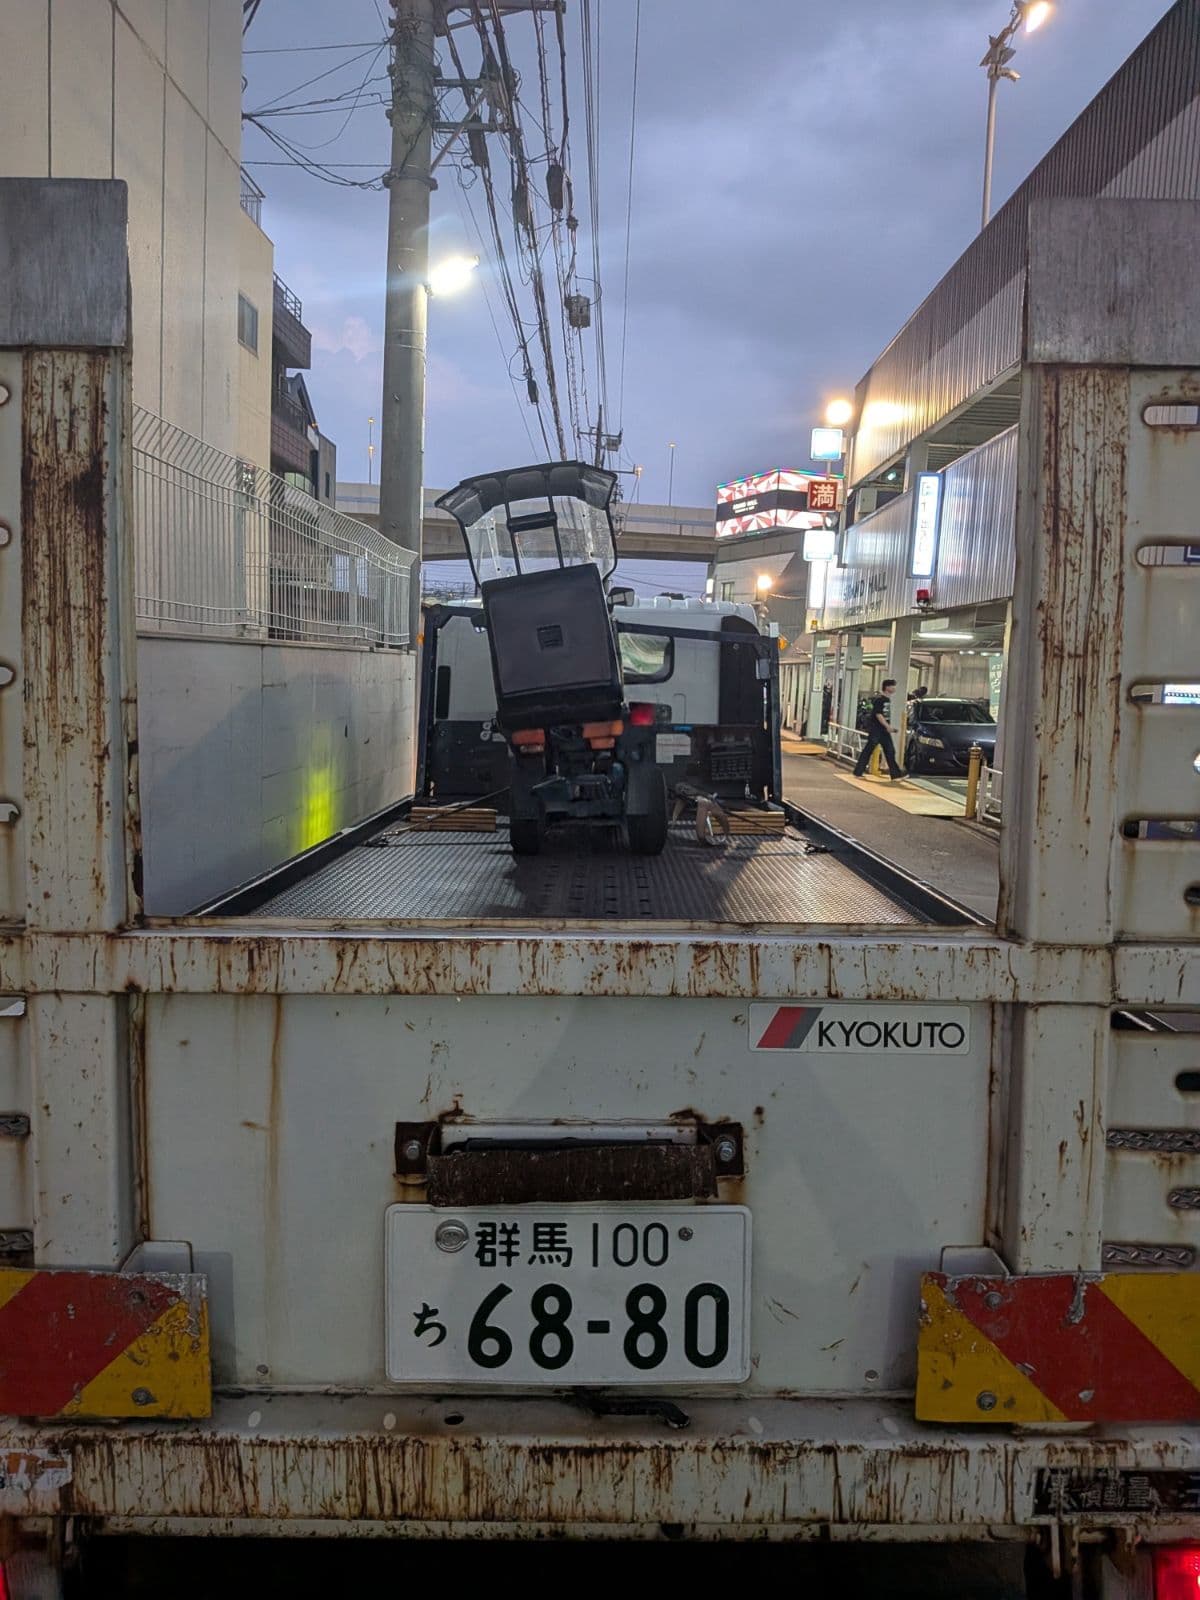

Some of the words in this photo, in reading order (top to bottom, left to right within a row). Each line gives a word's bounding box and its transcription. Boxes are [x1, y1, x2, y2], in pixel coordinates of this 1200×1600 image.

[812, 484, 835, 508] 満
[818, 1020, 965, 1048] KYOKUTO
[474, 1221, 573, 1268] 群馬
[592, 1222, 669, 1268] 100
[412, 1302, 447, 1347] ち
[467, 1282, 730, 1370] 68-80
